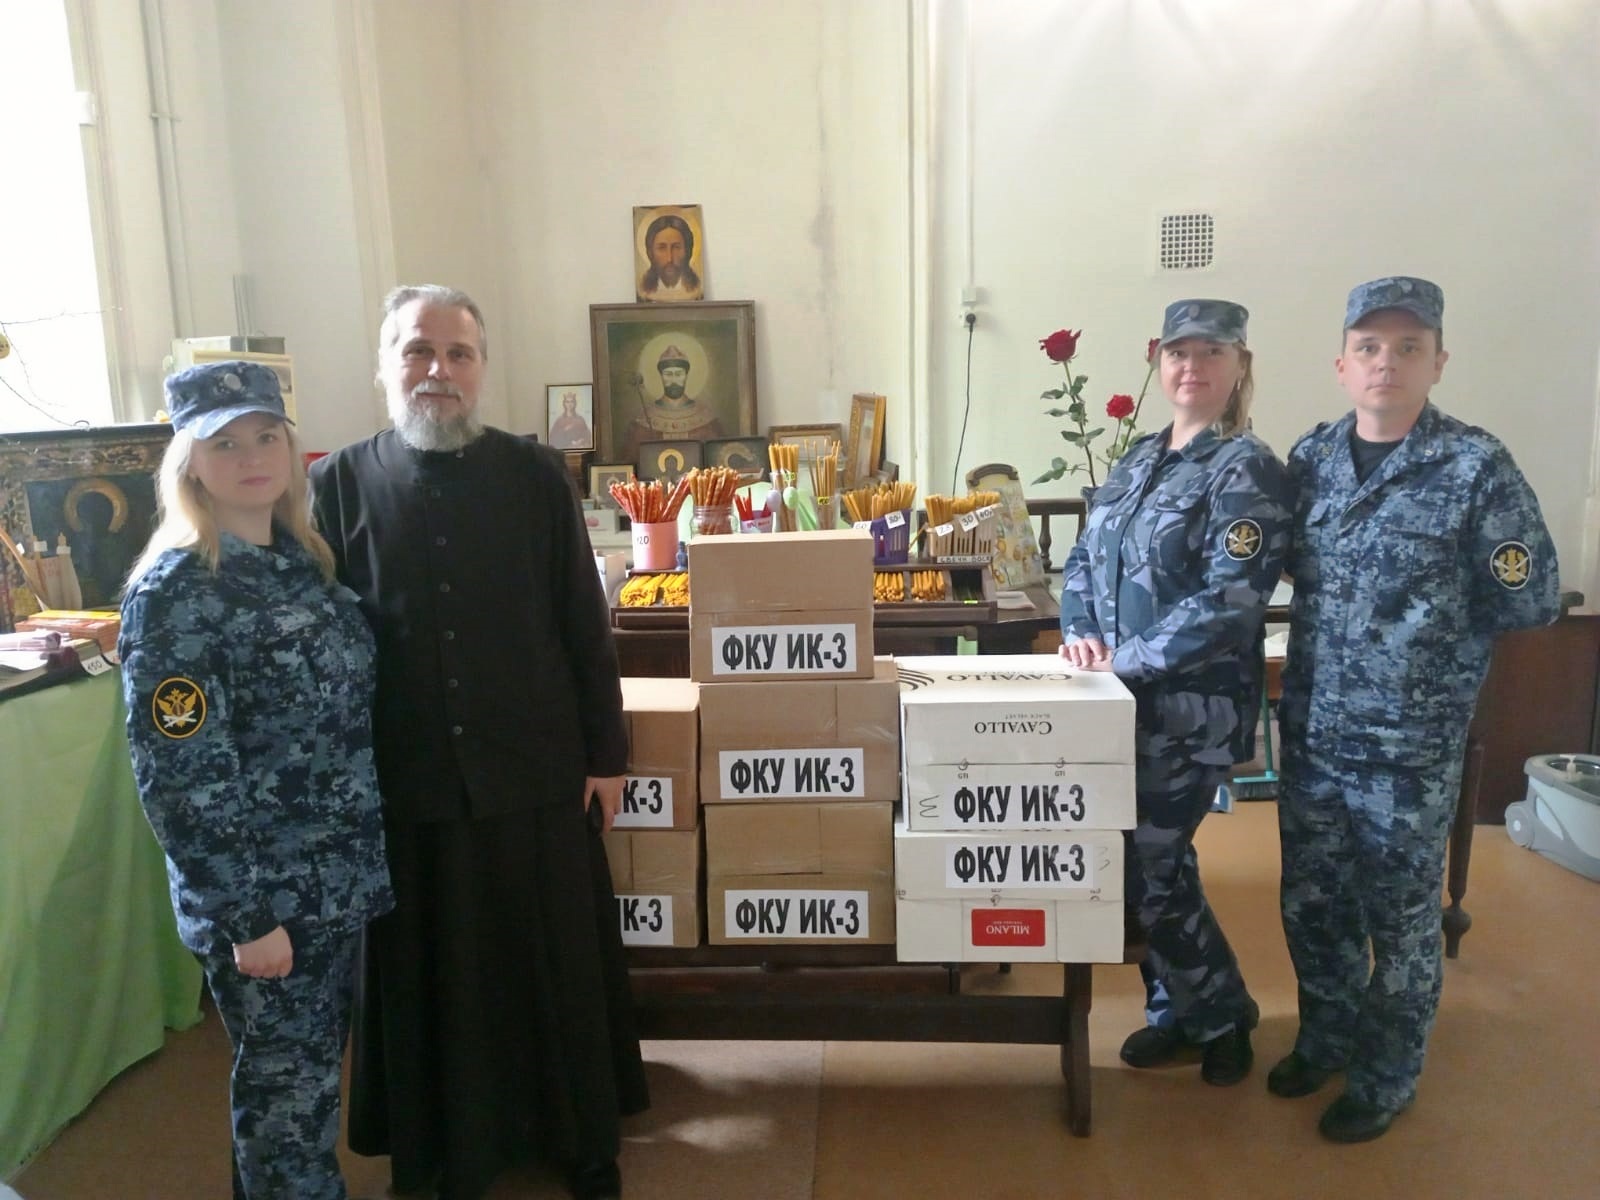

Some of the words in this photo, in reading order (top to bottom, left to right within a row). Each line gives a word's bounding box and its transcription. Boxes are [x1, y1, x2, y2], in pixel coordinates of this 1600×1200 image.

[722, 634, 777, 670] ФКУ
[787, 632, 847, 669] ИК-3
[974, 720, 1053, 735] CAVALLO
[730, 758, 785, 794] ФКУ
[794, 757, 855, 793] ИК-3
[622, 779, 663, 815] К-3
[954, 786, 1011, 823] ФКУ
[1021, 784, 1086, 822] ИК-3
[954, 846, 1011, 883] ФКУ
[1021, 844, 1086, 882] ИК-3
[620, 898, 663, 933] К-3
[735, 898, 790, 934] ФКУ
[799, 898, 860, 935] ИК-3
[985, 924, 1030, 935] MILANO
